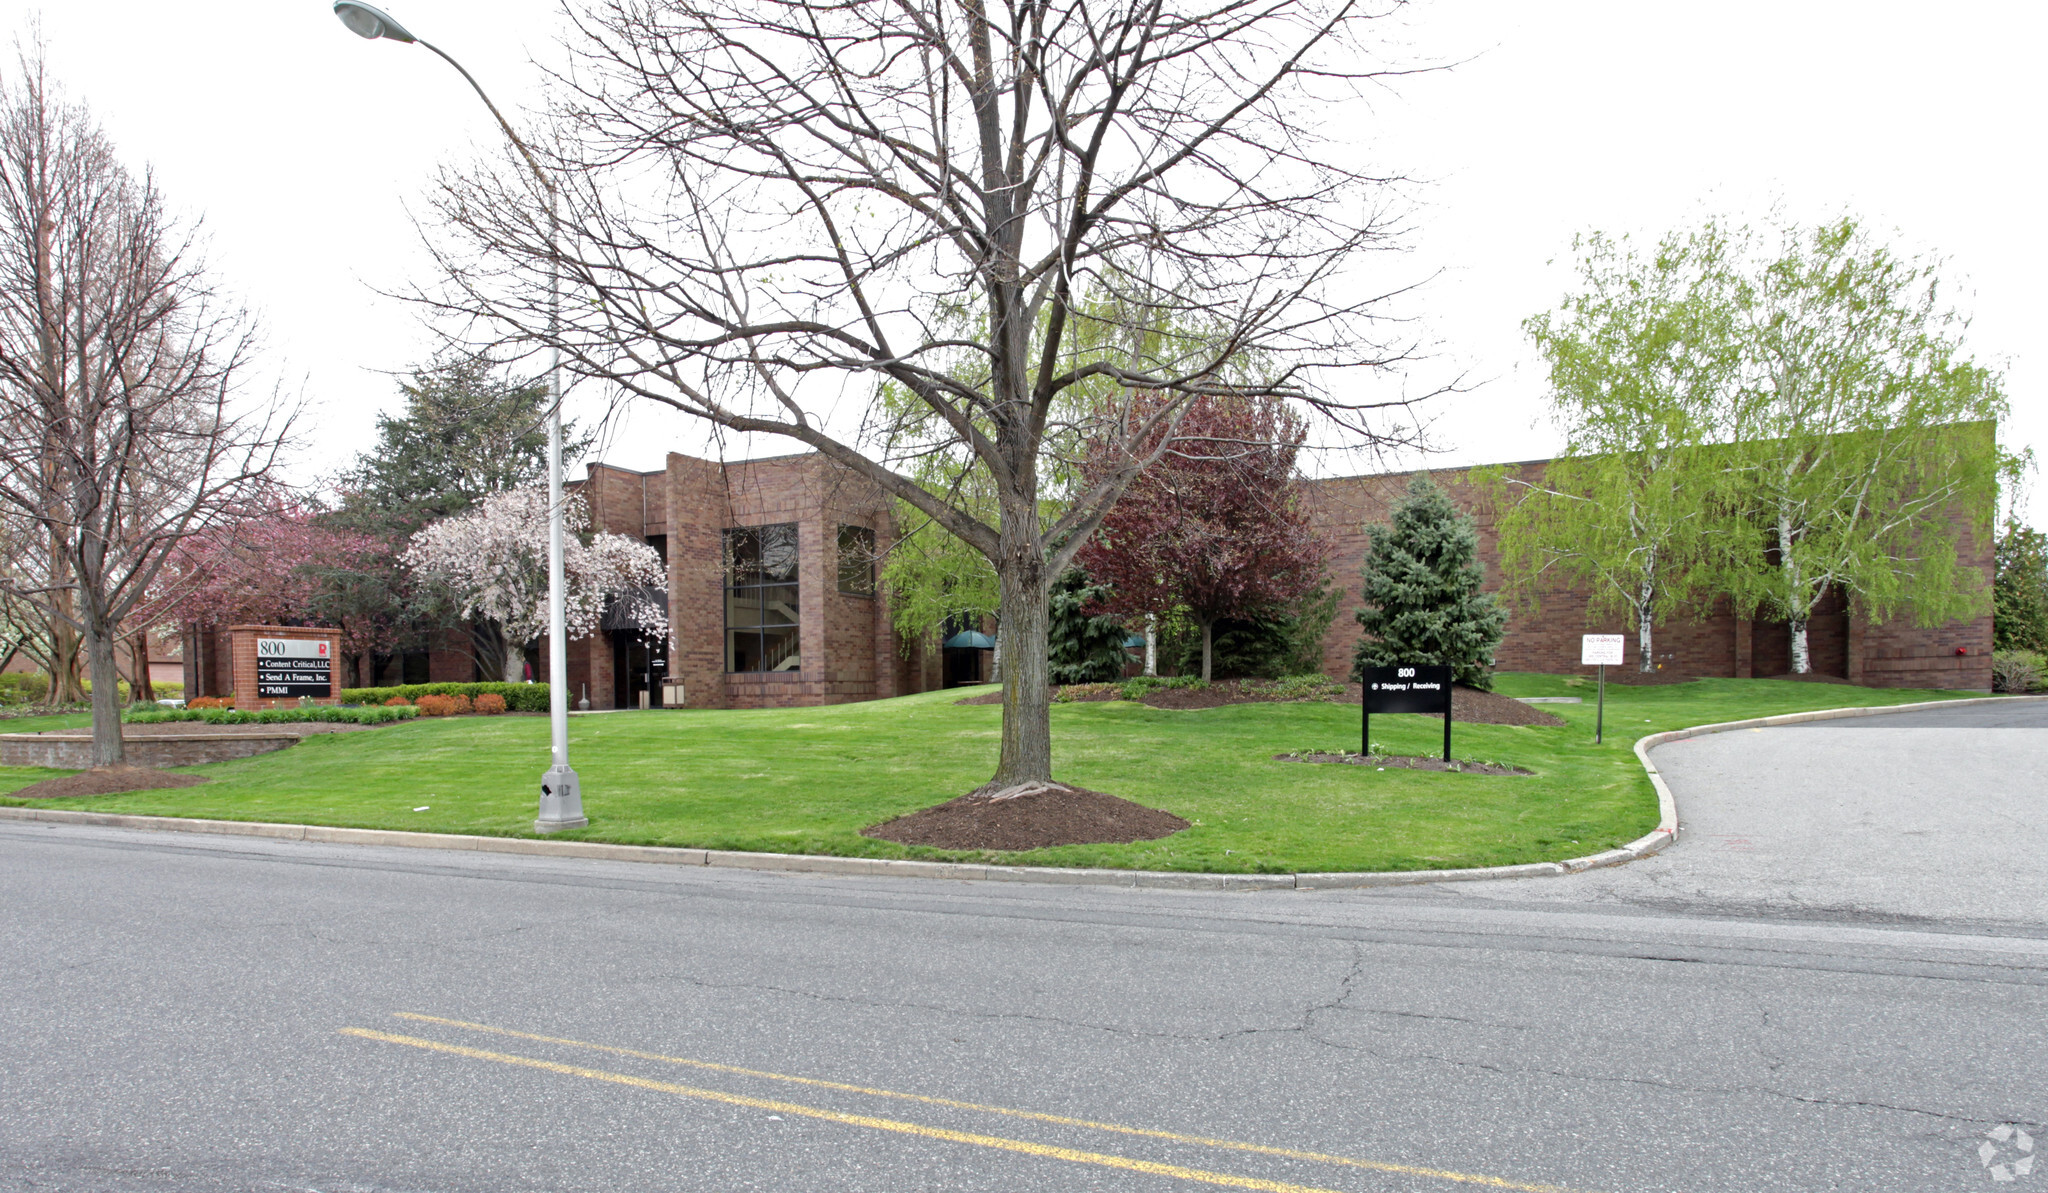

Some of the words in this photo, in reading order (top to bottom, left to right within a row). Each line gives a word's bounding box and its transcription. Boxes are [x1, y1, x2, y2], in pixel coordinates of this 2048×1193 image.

[260, 641, 285, 656] 800
[266, 660, 291, 668] Content
[1398, 668, 1415, 677] 800
